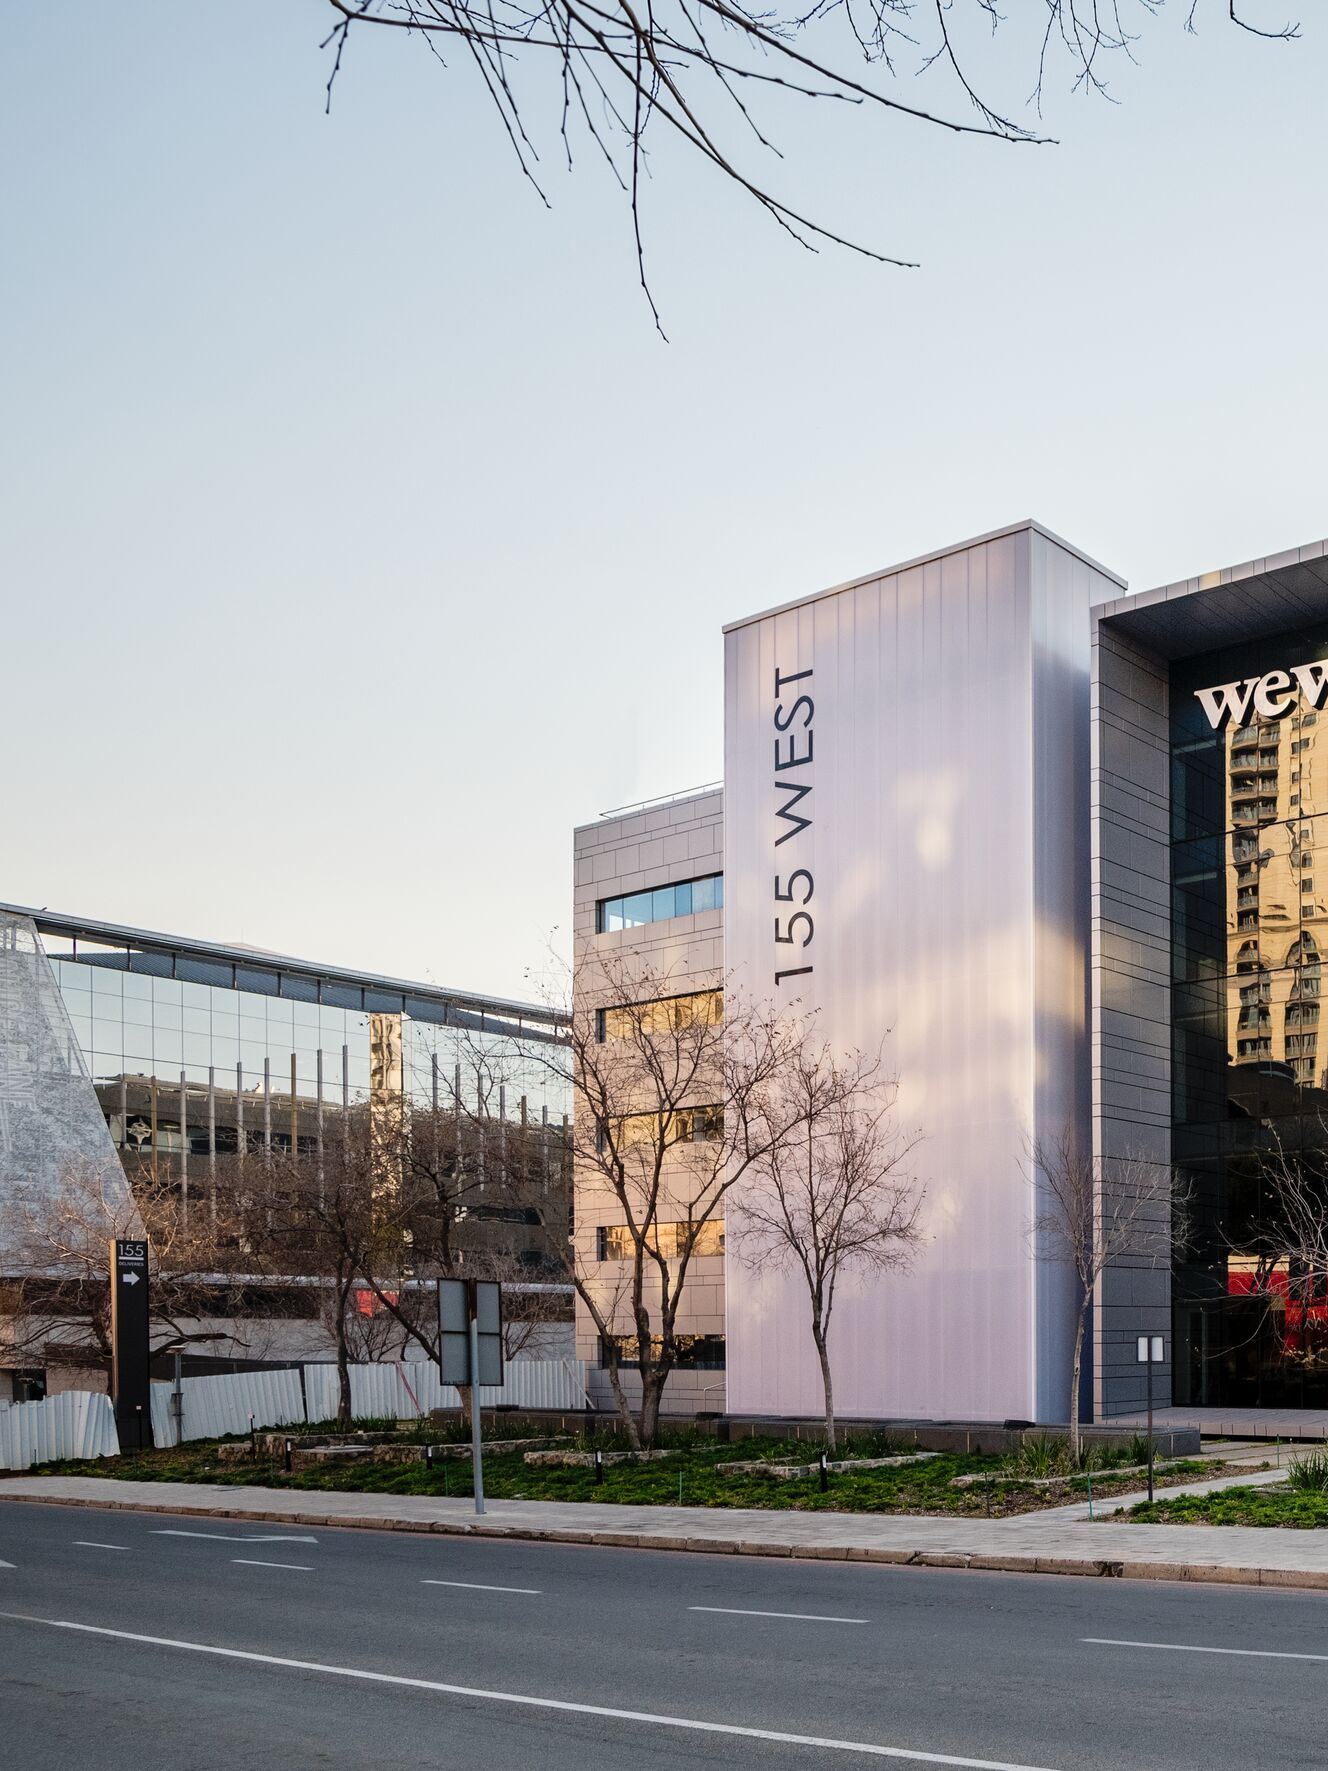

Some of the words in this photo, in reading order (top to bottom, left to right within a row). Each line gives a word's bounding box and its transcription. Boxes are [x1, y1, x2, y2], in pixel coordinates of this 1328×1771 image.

[774, 667, 814, 847] WEST
[774, 868, 814, 986] 155
[119, 1244, 144, 1256] 155
